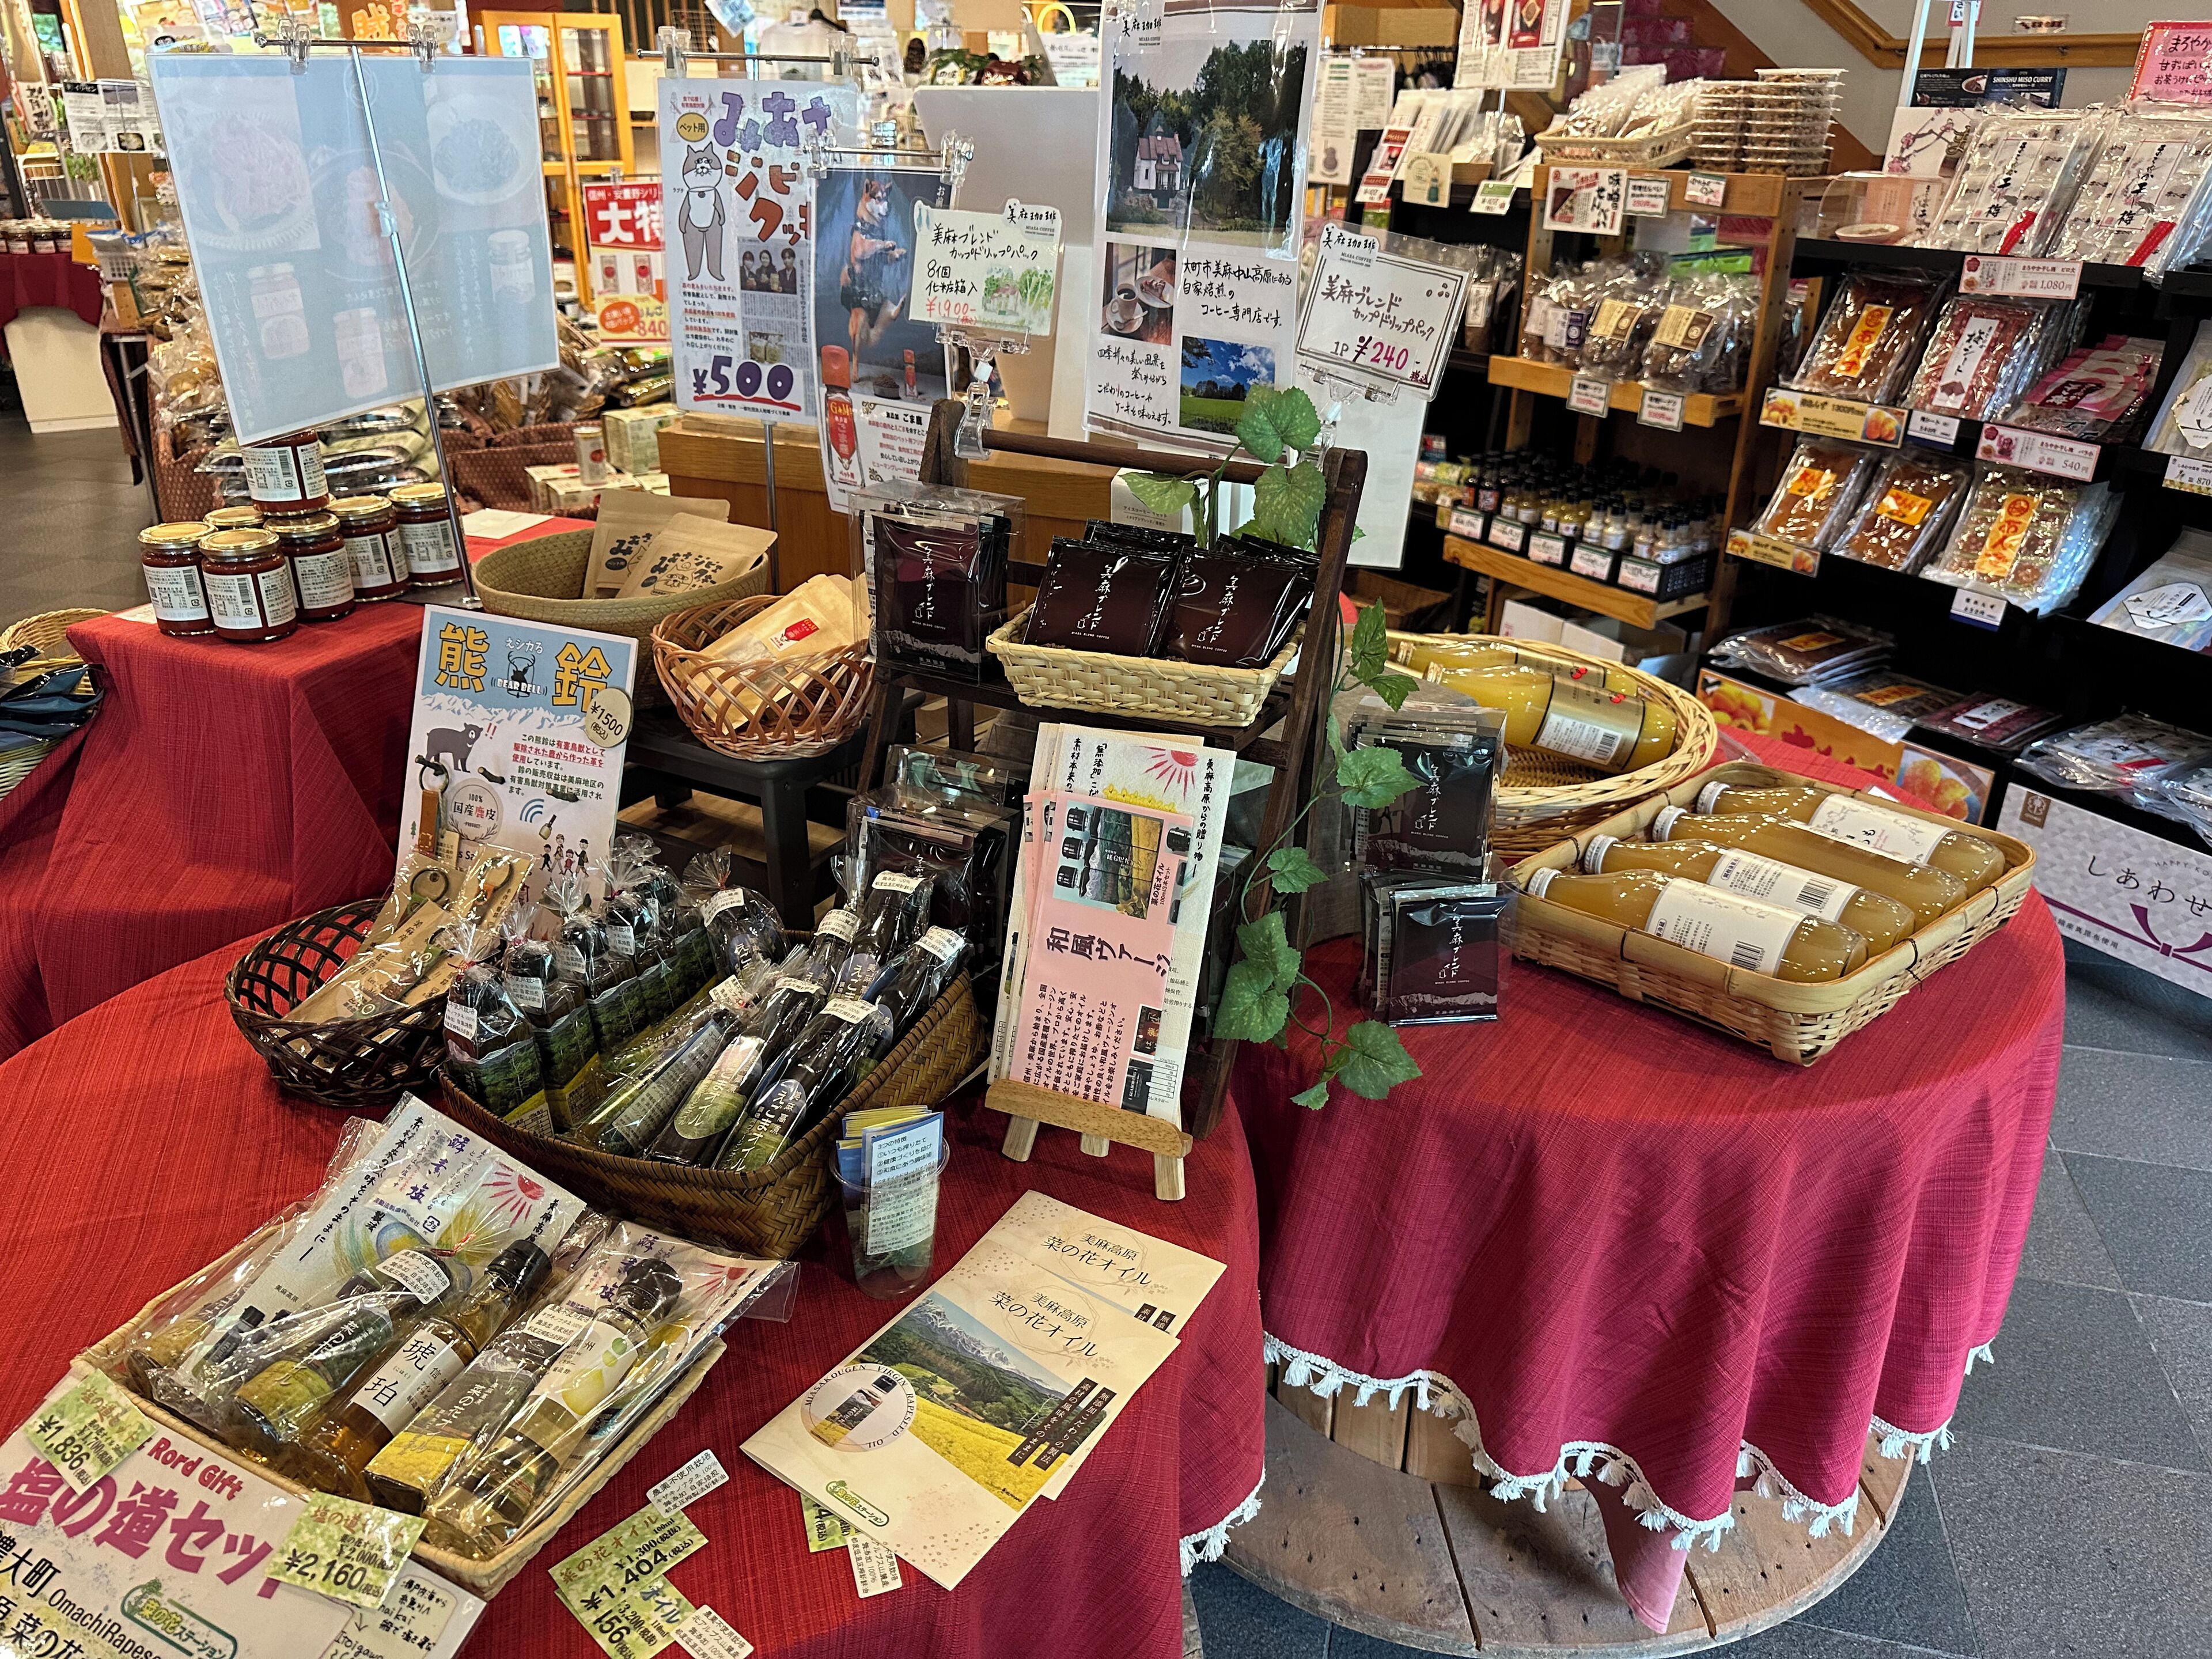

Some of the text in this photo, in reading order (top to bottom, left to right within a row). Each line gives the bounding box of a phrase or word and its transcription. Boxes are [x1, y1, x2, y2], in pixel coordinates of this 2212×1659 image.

[680, 123, 705, 133] ペット用
[1007, 203, 1056, 224] 美麻珈琲
[931, 223, 999, 246] 美麻ブレンド
[1322, 225, 1376, 253] 美麻珈琲
[927, 259, 950, 279] 8個
[949, 245, 1038, 260] カップドリップパック
[925, 279, 978, 296] 化粧箱入
[1183, 257, 1292, 286] 大町市美麻中山高原にある
[1183, 278, 1235, 300] 自家焙煎の
[1321, 275, 1402, 313] 美麻ブレンド
[1201, 304, 1283, 328] コーヒー専門店です。
[1353, 307, 1435, 342] カップドリップパック
[1097, 345, 1165, 370] 四季折々の美しい風景を
[1330, 341, 1349, 357] 1P
[693, 355, 793, 400] ¥500
[1097, 382, 1153, 402] こだわりのコーヒーや
[1131, 368, 1167, 385] 楽しみながら
[1410, 370, 1431, 385] 税込
[1115, 400, 1172, 426] ケーキを味わえます。
[610, 533, 653, 555] みあさ
[650, 552, 692, 574] みあさ
[922, 546, 935, 620] 美麻ブレンド
[1096, 565, 1113, 630] 美麻ブレンド
[1219, 575, 1238, 643] 美麻ブレンド
[505, 637, 543, 654] えシカる
[435, 622, 612, 713] 熊 鈴
[497, 677, 542, 695] BEAR BELL
[590, 701, 623, 736] ¥1500
[590, 722, 609, 741] (税込)
[513, 743, 604, 767] 駆除された鹿から作った革を
[522, 734, 605, 756] この熊鈴は有害鳥獣として
[512, 753, 563, 771] 使用しています。
[518, 766, 604, 789] 鈴の販売収益は美麻地区の
[468, 793, 483, 801] 100%
[509, 786, 524, 796] ます。
[1426, 764, 1441, 830] 美麻ブレンド
[453, 802, 497, 820] 国産鹿皮
[1151, 863, 1164, 905] 菜の花オイル
[2088, 855, 2212, 918] しあわせ
[1449, 916, 1463, 978] 美麻ブレンド
[2055, 917, 2119, 949] 館産真昆布使用
[1024, 984, 1048, 1083] 信州・美麻から始まり、全国
[1033, 987, 1056, 1085] に広がる国産菜種ヴァージン
[1043, 991, 1067, 1088] オイルの世界。プロから高く
[1052, 991, 1077, 1091] 評価されています。安心・安
[1062, 994, 1086, 1094] 全とともに搾りたてのオイル
[1072, 1009, 1095, 1096] をご家庭にお届けします。
[1082, 1001, 1107, 1100] 味噌やしょうゆ、お酢などと
[1092, 1002, 1118, 1102] 相性の良い和風ヴァージンオ
[1103, 1017, 1126, 1105] イルをお楽しみください。
[730, 1090, 788, 1172] えごまオイル
[877, 1136, 907, 1149] 3つの特徴
[877, 1137, 927, 1158] ①いつも搾りたて
[877, 1143, 933, 1166] ②健康づくりを助け
[1041, 1235, 1153, 1286] 菜の花オイル
[1082, 1232, 1140, 1262] 美麻高原
[988, 1290, 1099, 1359] 菜の花オイル
[1032, 1292, 1092, 1330] 美麻高原
[363, 1338, 437, 1407] 琥珀
[393, 1365, 412, 1380] (こはく)
[429, 1366, 450, 1389] 信州
[805, 1364, 915, 1449] MIASAKOUGEN VIRGIN RAPESEED OIL
[1014, 1382, 1091, 1460] 素材の風味をそのままに
[1039, 1391, 1111, 1465] 無添加こだわりの製法
[36, 1414, 92, 1486] ¥1,836(税込)
[148, 1437, 202, 1475] Rord
[651, 1452, 712, 1498] 農薬不使用栽培
[691, 1470, 719, 1491] 自家焙煎
[836, 1488, 884, 1524] 菜の花ステーション
[0, 1456, 283, 1600] 塩の道セッ
[653, 1517, 675, 1535] 100ml
[559, 1515, 659, 1584] 菜の花オイル
[614, 1525, 682, 1570] ¥1,300(税抜)
[284, 1548, 385, 1598] ¥2,160(税込)
[580, 1538, 694, 1611] ¥1,404(税込)
[868, 1566, 878, 1583] 100%
